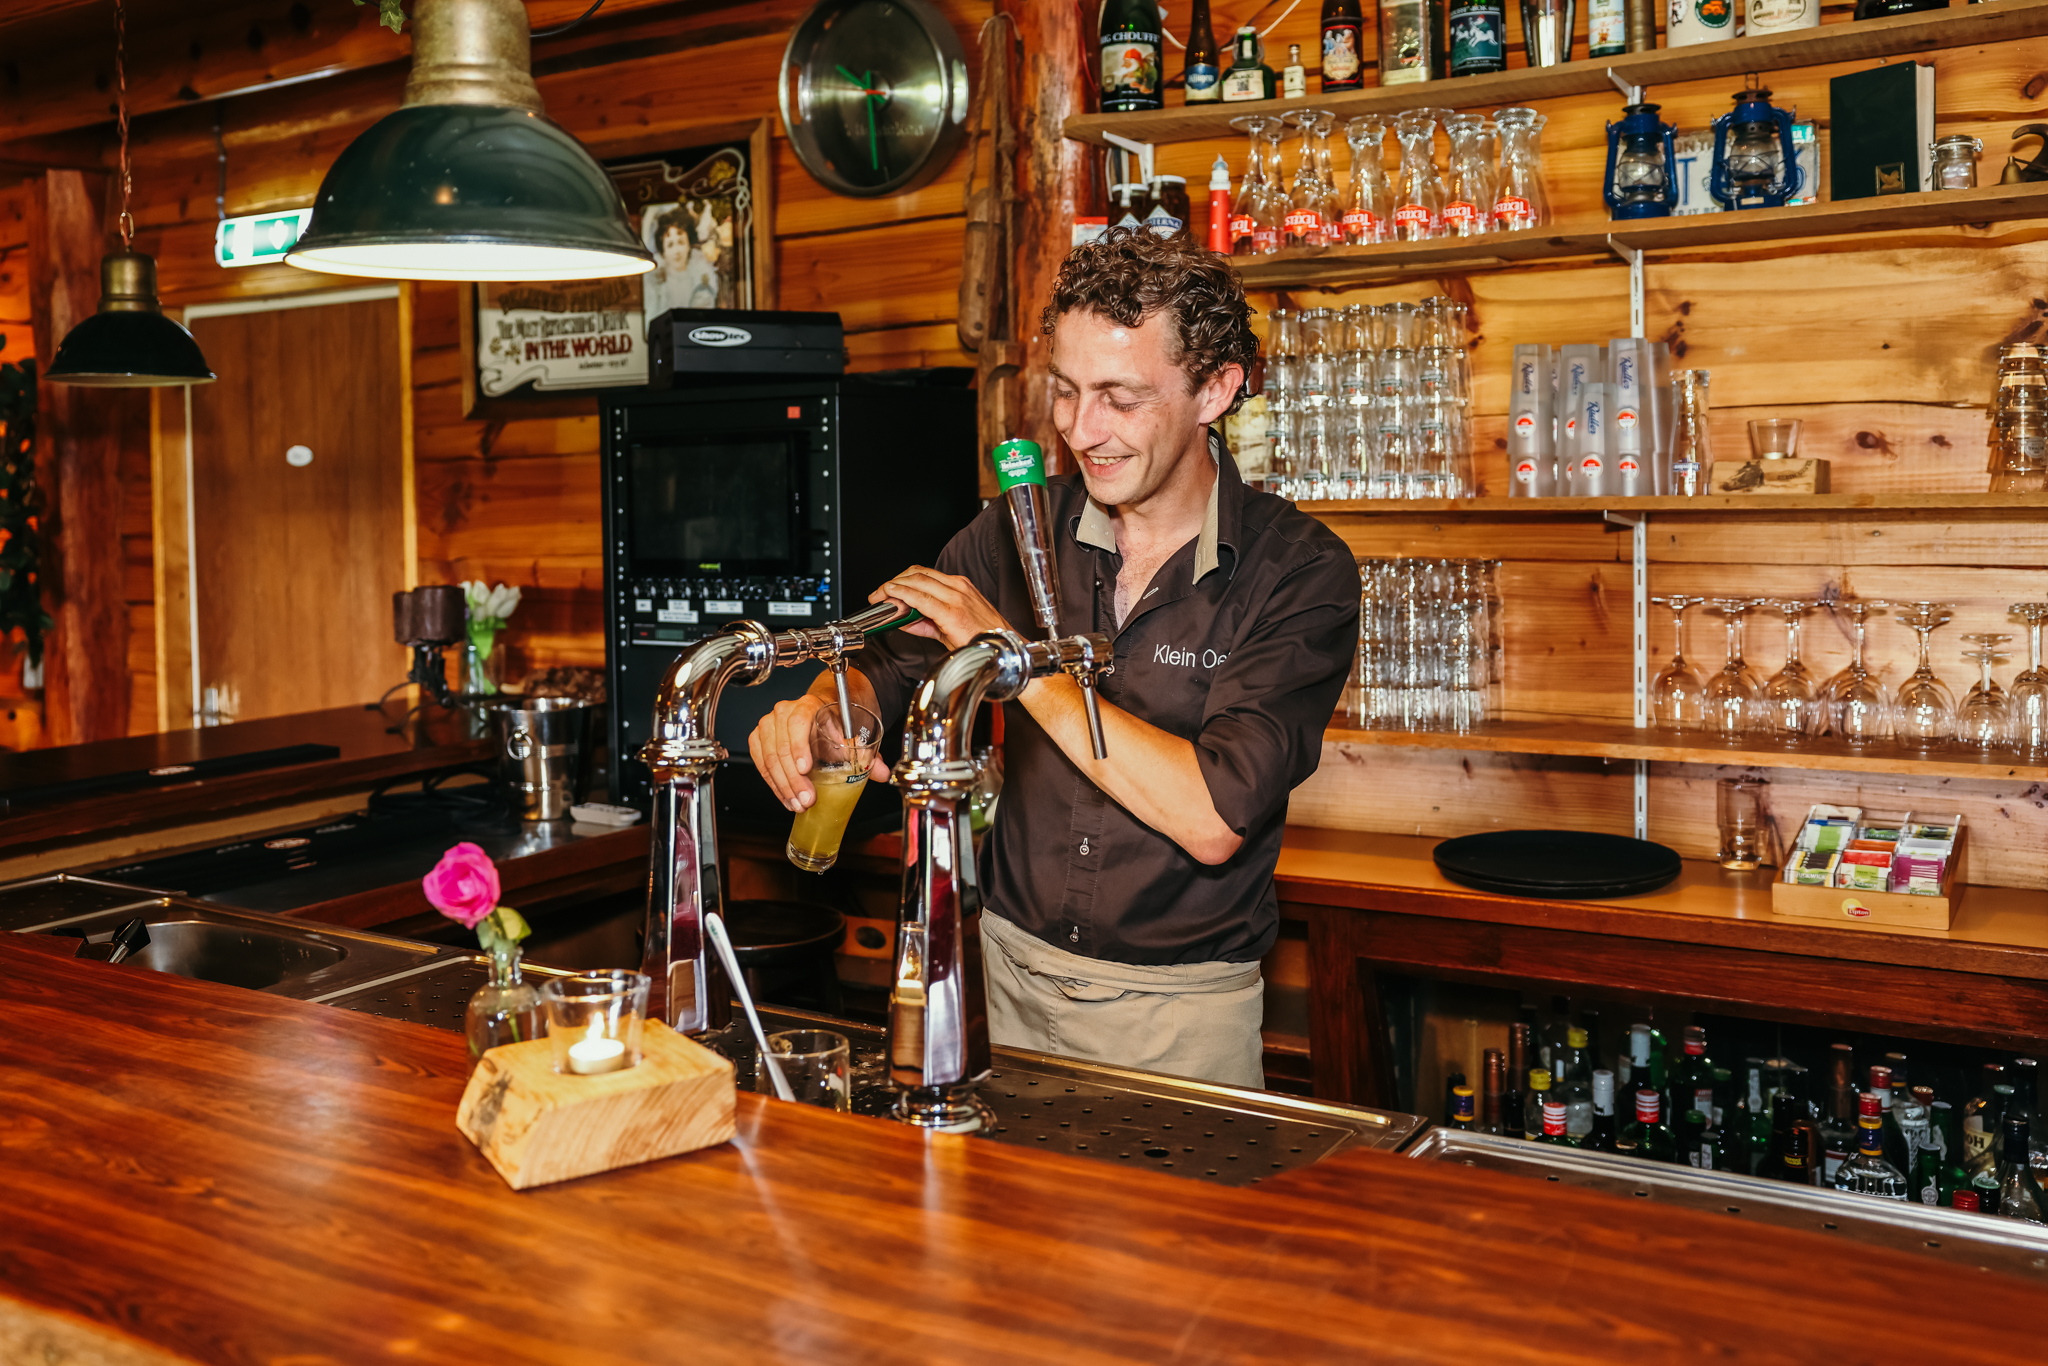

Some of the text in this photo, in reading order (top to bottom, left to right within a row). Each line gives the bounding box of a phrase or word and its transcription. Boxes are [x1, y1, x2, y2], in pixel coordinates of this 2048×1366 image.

[1284, 214, 1319, 229] TEXELS
[1396, 209, 1430, 223] TEXELS
[525, 333, 633, 361] IN THE WORLD
[1153, 643, 1231, 669] Klein Oe
